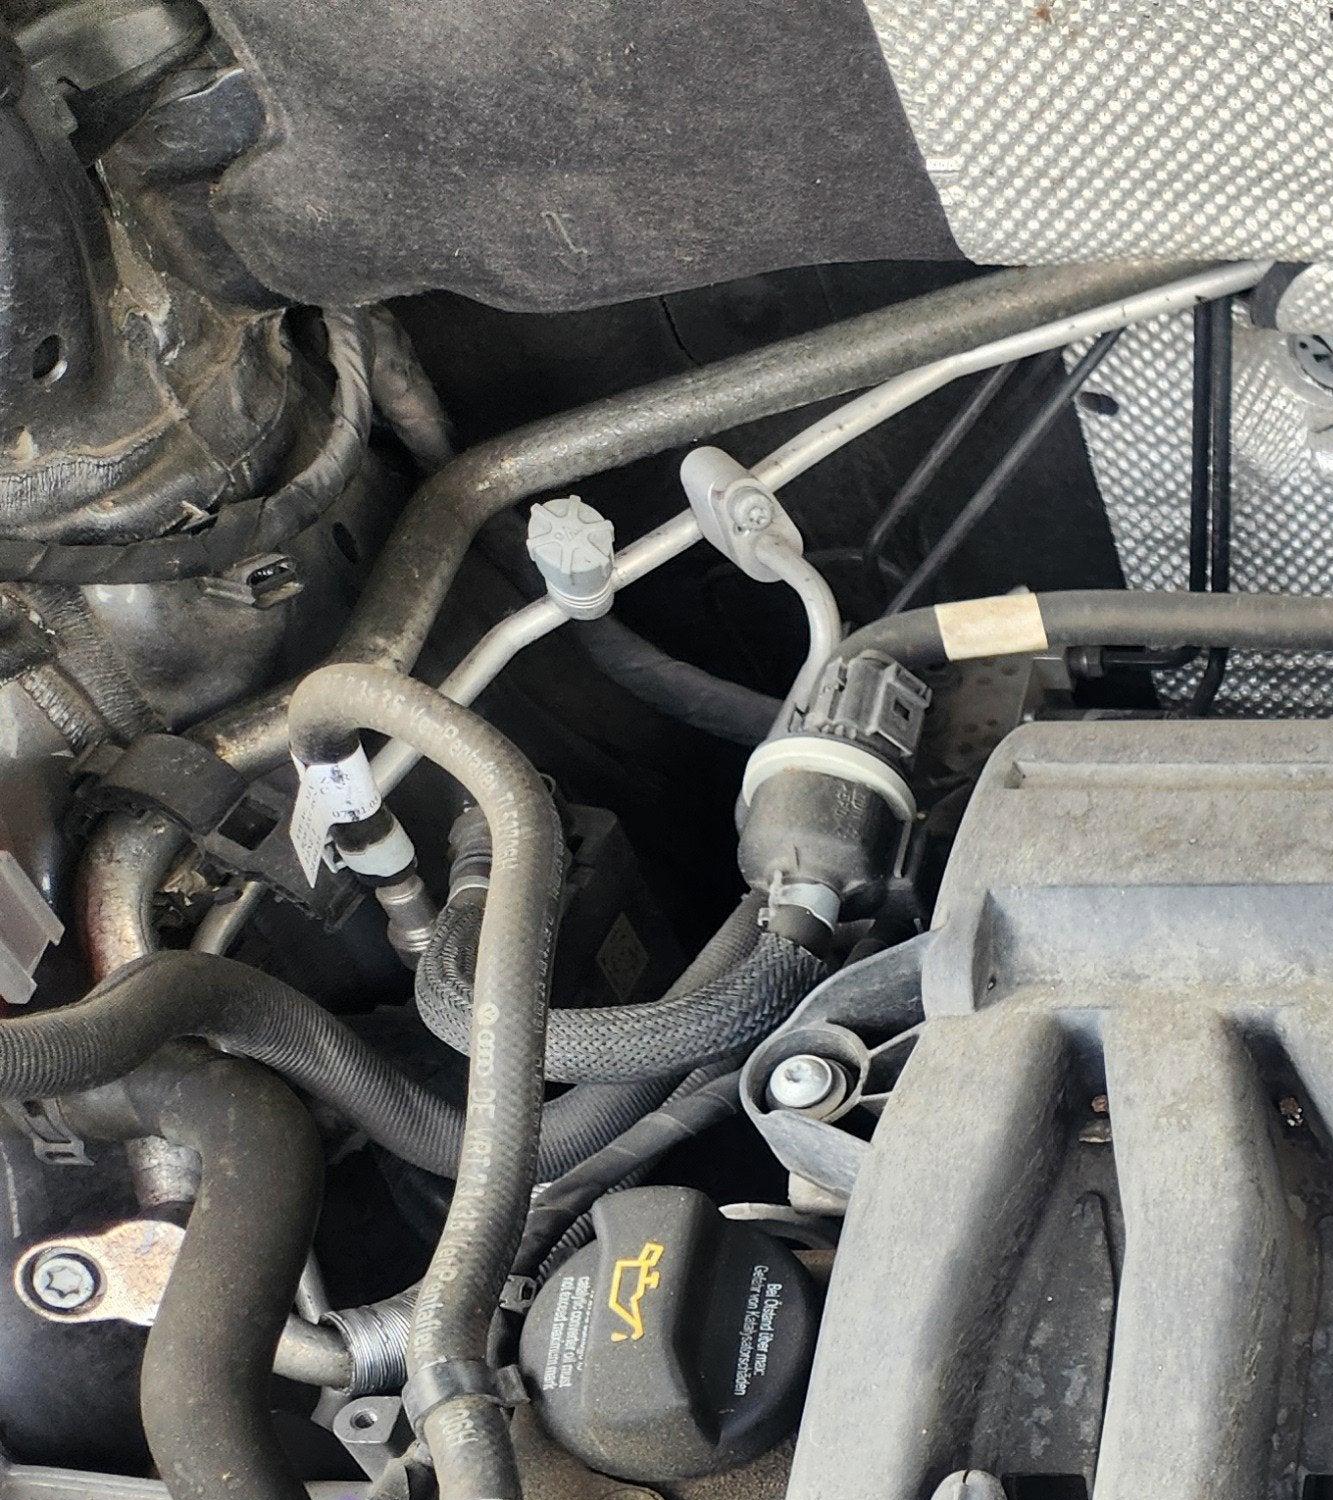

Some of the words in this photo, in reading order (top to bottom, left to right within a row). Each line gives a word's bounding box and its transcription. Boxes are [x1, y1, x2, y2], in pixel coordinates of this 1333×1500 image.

[560, 1276, 575, 1291] not
[750, 1265, 769, 1293] Gefahr
[765, 1283, 782, 1298] Bei
[553, 1291, 572, 1322] exceed
[747, 1294, 760, 1309] von
[564, 1310, 582, 1351] converter
[757, 1332, 774, 1353] über
[543, 1365, 558, 1391] mark
[559, 1364, 573, 1388] must
